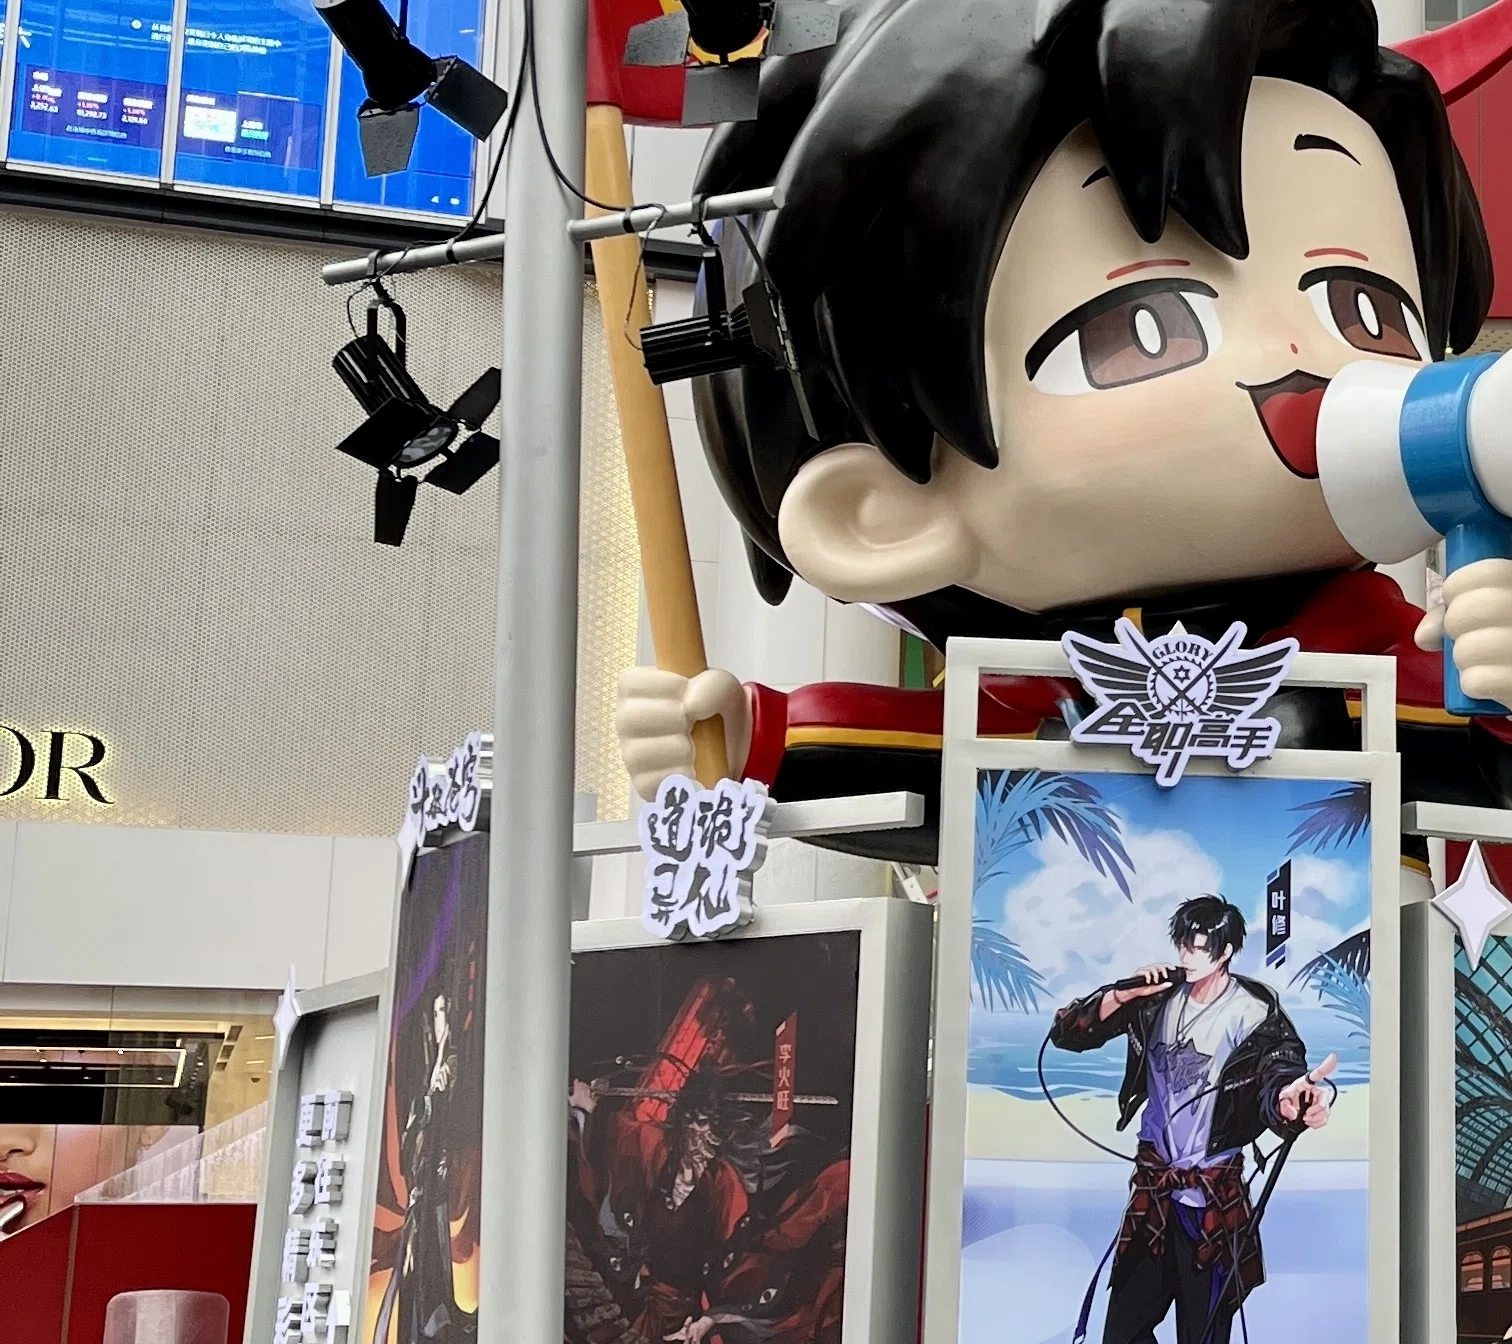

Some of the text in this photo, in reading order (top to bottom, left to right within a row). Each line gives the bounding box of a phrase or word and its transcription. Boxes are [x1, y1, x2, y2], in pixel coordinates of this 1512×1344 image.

[1151, 640, 1214, 662] GLORY
[1079, 700, 1273, 779] 全职高手
[776, 1043, 793, 1111] 李火旺
